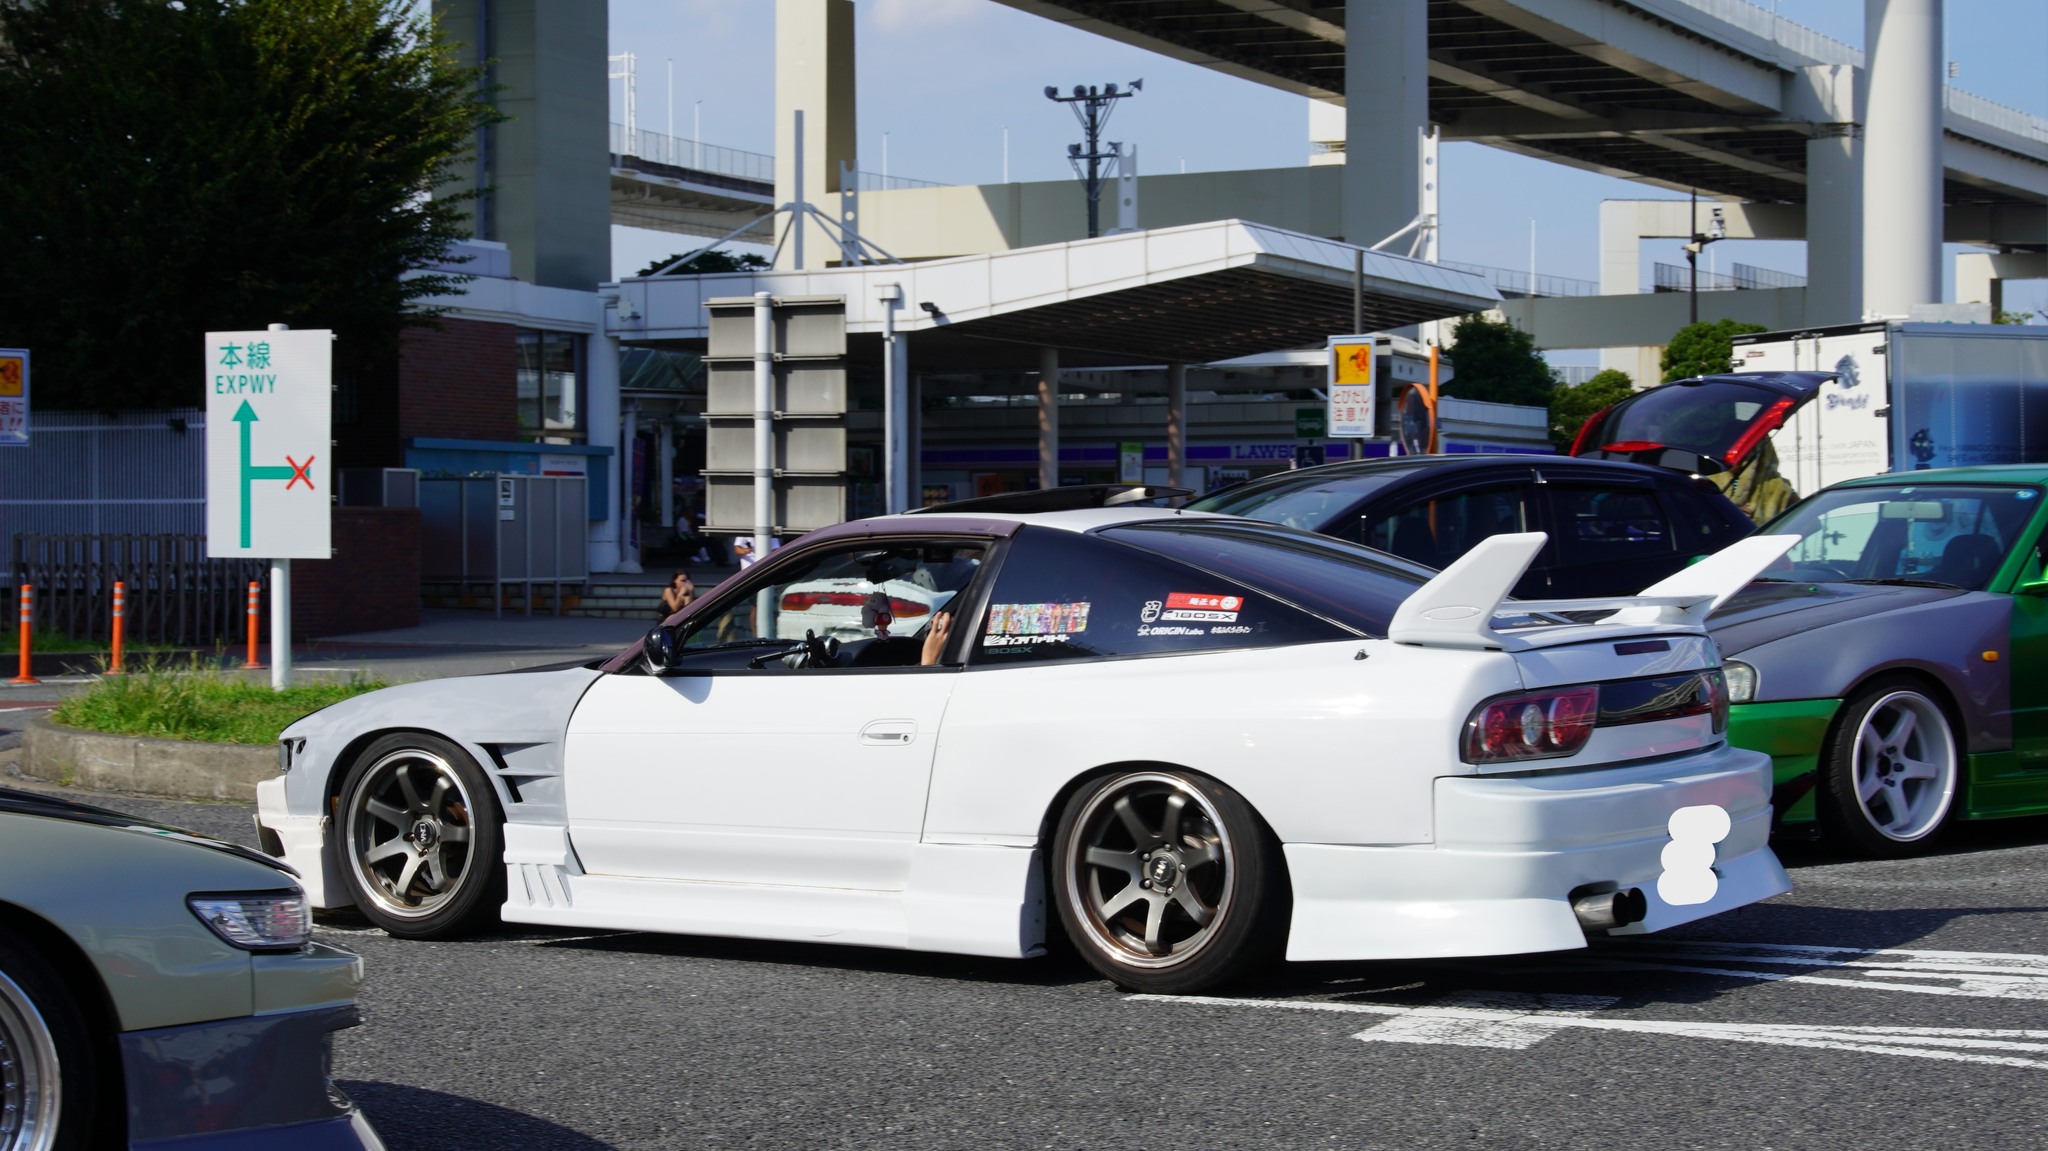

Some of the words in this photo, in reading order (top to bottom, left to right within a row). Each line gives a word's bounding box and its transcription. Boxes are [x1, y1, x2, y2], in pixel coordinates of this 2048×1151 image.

[219, 341, 271, 370] 本線
[215, 374, 277, 394] EXPWY
[1333, 390, 1369, 404] とびだし
[1235, 444, 1297, 459] LAWSO
[1175, 612, 1233, 620] 180SX
[1150, 626, 1187, 636] ORIGIN
